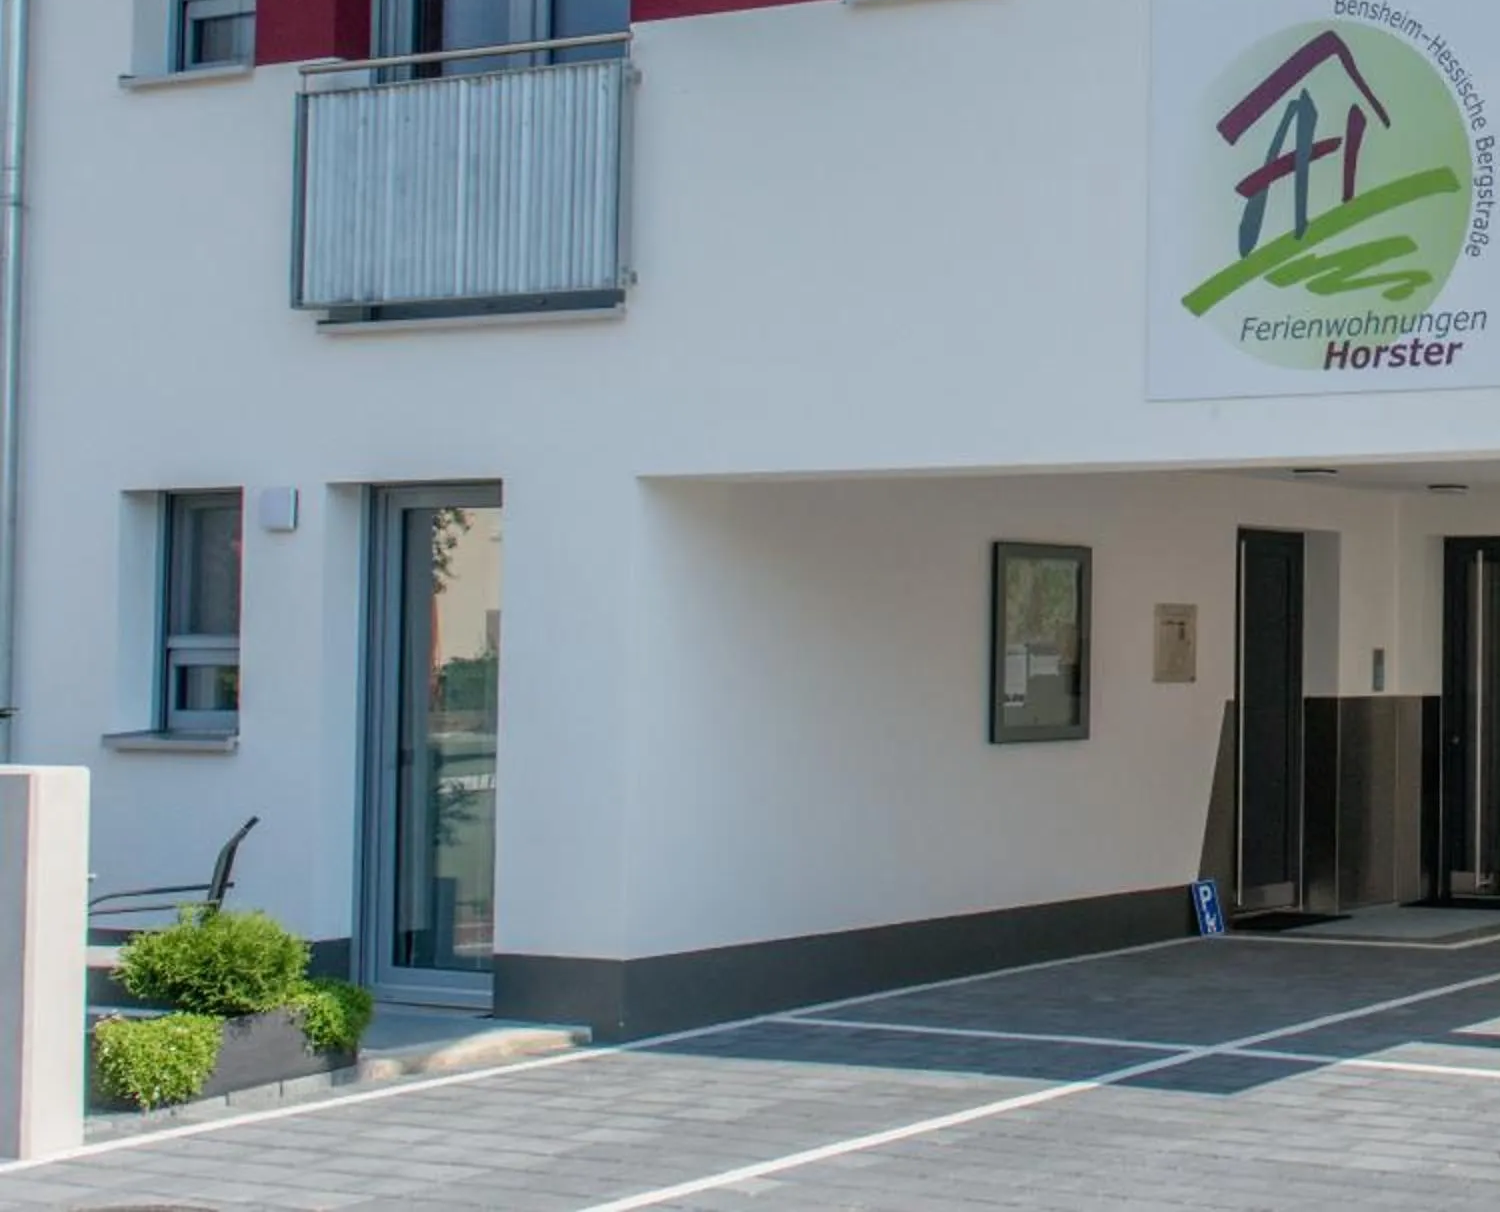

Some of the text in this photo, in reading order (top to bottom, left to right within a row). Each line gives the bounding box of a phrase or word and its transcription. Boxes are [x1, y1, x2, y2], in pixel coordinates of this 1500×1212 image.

[1465, 135, 1495, 257] Bergstraße
[1240, 308, 1487, 341] Ferienwohnungen
[1323, 338, 1463, 370] Horster
